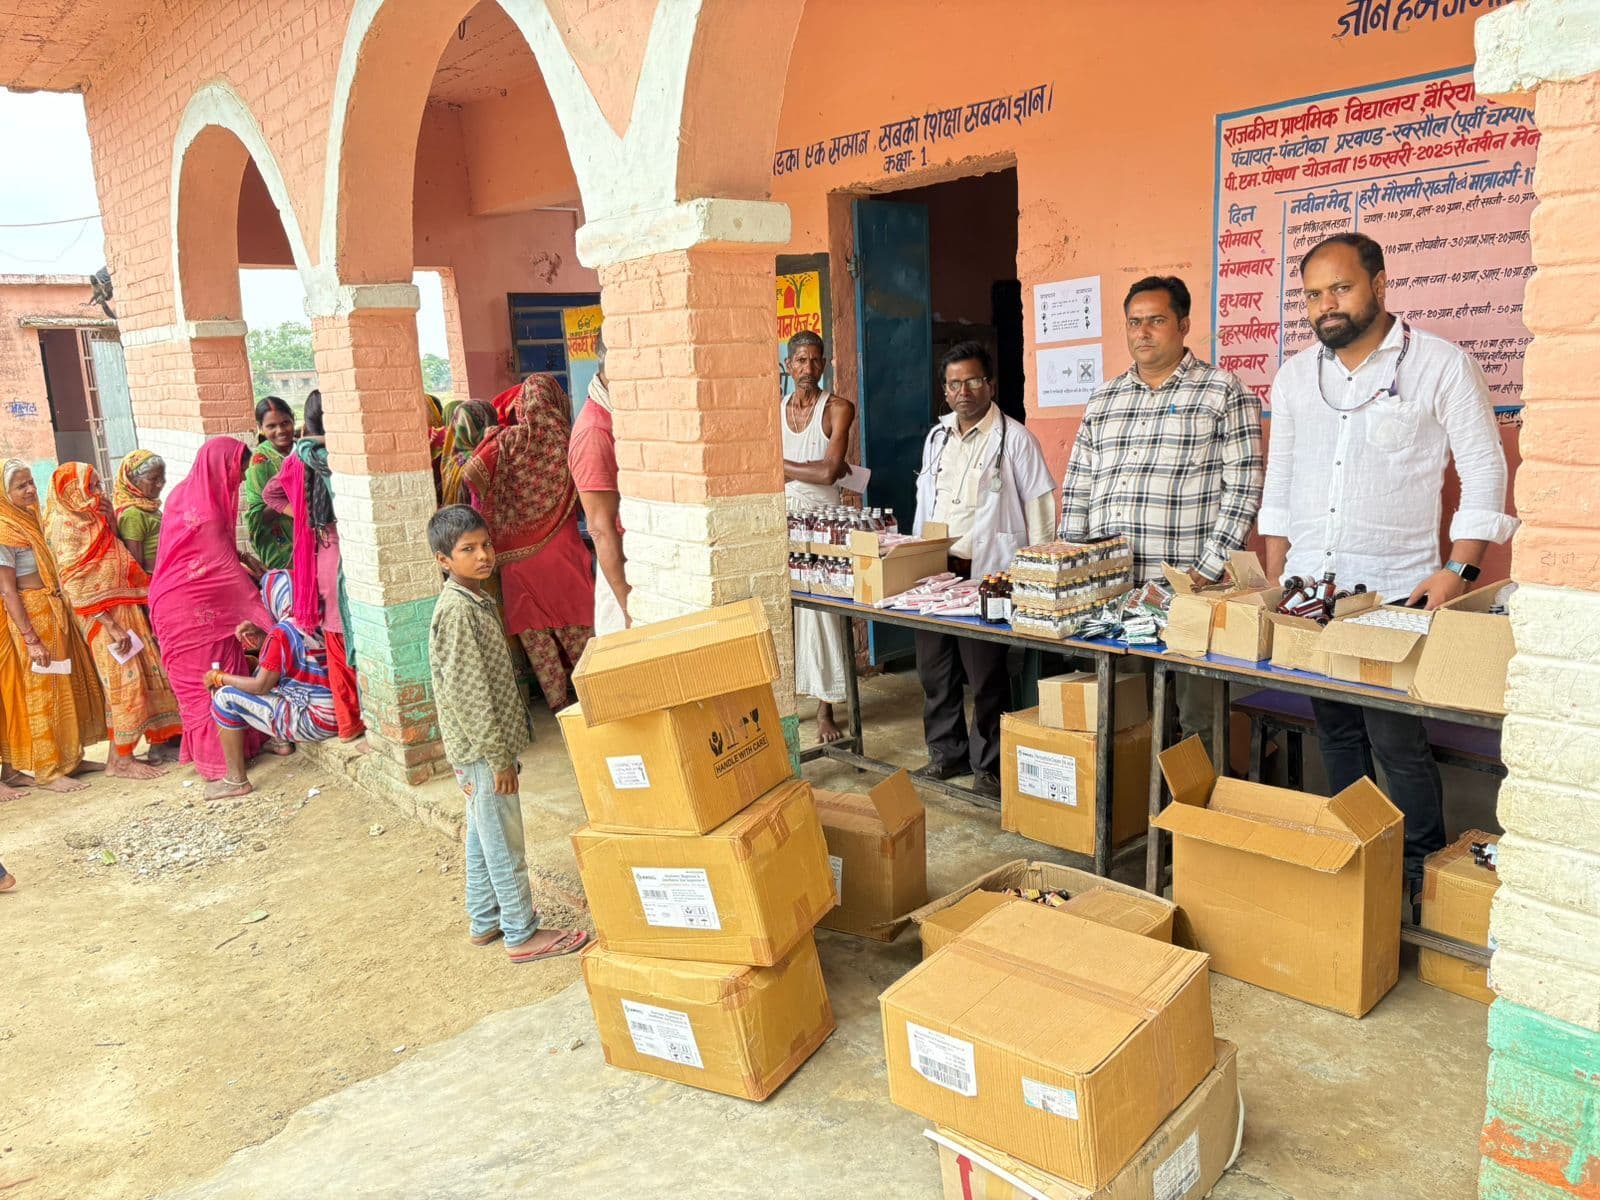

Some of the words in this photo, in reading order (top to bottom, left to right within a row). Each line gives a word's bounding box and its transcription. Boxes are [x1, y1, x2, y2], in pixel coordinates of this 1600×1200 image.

[828, 129, 871, 165] समान
[922, 105, 963, 145] शिक्षा
[1222, 116, 1279, 148] राजकीय
[1280, 104, 1340, 139] प्राथमिक
[1301, 157, 1352, 179] योजना
[1467, 130, 1509, 154] नवीन
[1290, 192, 1326, 215] नवीन
[1358, 183, 1381, 210] हरी
[1218, 229, 1264, 254] सोमवार
[1218, 257, 1276, 279] मंगलवार
[1218, 292, 1264, 318] बुधवार
[715, 753, 739, 774] HANDLE
[738, 745, 753, 760] WITH
[752, 736, 767, 752] CARE
